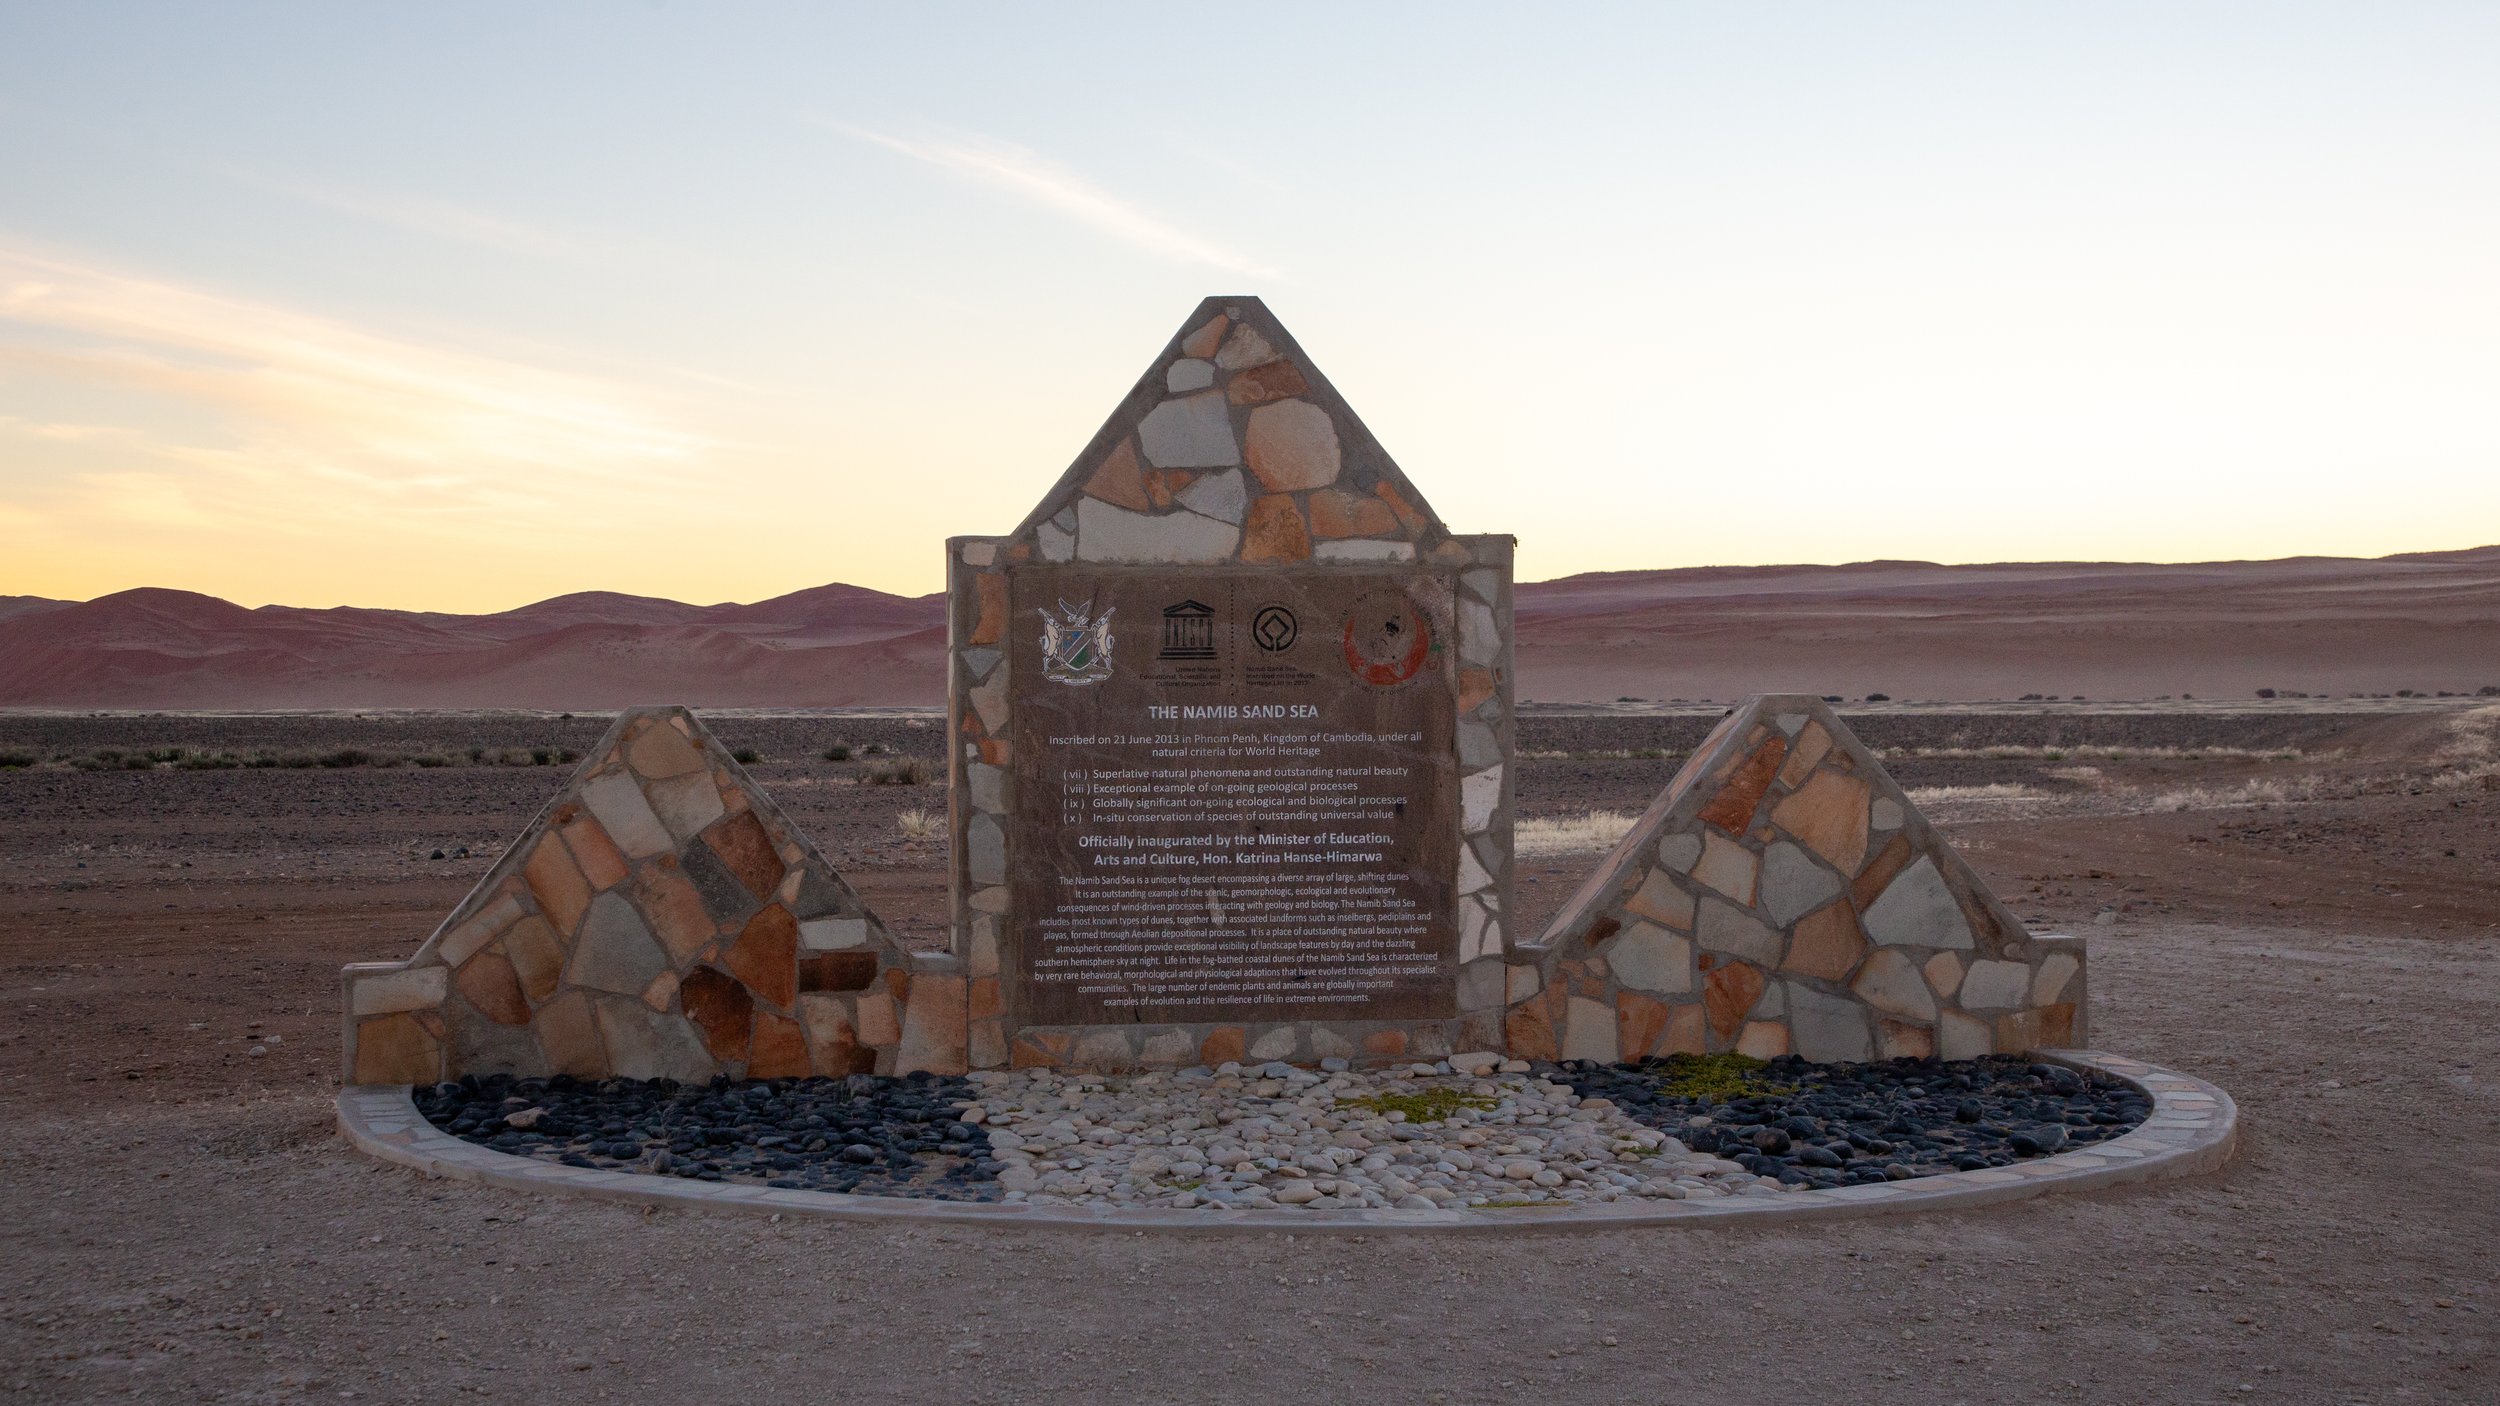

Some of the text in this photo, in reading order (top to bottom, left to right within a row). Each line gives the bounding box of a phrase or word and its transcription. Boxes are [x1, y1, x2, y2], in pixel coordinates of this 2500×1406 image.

[1148, 705, 1318, 718] THE NAMIB SAND SEA
[1113, 735, 1125, 744] 21
[1128, 735, 1151, 744] June
[1155, 734, 1179, 743] 2013
[1182, 734, 1191, 743] in
[1194, 734, 1229, 743] Phnom
[1232, 734, 1260, 744] Penh,
[1263, 733, 1306, 744] Kingdom
[1310, 733, 1320, 742] of
[1322, 732, 1375, 743] Cambodia,
[1378, 732, 1407, 741] under
[1410, 732, 1421, 741] all
[1152, 746, 1320, 757] natural criteria for World Heritage
[1093, 769, 1149, 780] Superlative
[1152, 768, 1187, 777] natural
[1190, 768, 1250, 779] phenomena
[1252, 767, 1271, 776] and
[1274, 767, 1333, 778] outstanding
[1336, 767, 1371, 776] natural
[1374, 766, 1408, 777] beauty
[1093, 783, 1150, 794] Exceptional
[1153, 783, 1195, 794] example
[1198, 782, 1208, 791] of
[1210, 782, 1254, 793] on-going
[1257, 782, 1306, 793] geological
[1310, 784, 1358, 792] processes
[1092, 798, 1133, 809] Globally
[1136, 797, 1186, 808] significant
[1189, 797, 1233, 808] on-going
[1236, 796, 1284, 808] ecological
[1287, 796, 1306, 805] and
[1309, 796, 1356, 807] biological
[1359, 798, 1407, 806] processes
[1091, 812, 1124, 821] In-situ
[1127, 812, 1191, 821] conservation
[1194, 812, 1204, 820] of
[1207, 811, 1243, 822] species
[1245, 811, 1256, 820] of
[1258, 811, 1317, 822] outstanding
[1320, 810, 1364, 819] universal
[1367, 810, 1394, 819] value
[1078, 834, 1393, 849] Officially inaugurated by the Minister of Education,
[1094, 852, 1382, 865] Arts and Culture, Hon. Katrina Hanse-Himarwa
[1150, 875, 1176, 885] unique
[1178, 875, 1190, 885] fog
[1217, 874, 1269, 884] encompassing
[1305, 875, 1324, 883] array
[1357, 873, 1384, 883] shifting
[1101, 890, 1146, 900] outstanding
[1295, 887, 1331, 897] ecological
[1349, 887, 1395, 896] evolutionary
[1057, 905, 1109, 913] consequences
[1167, 904, 1203, 912] processes
[1264, 901, 1293, 911] geology
[1056, 944, 1102, 954] atmospheric
[1144, 943, 1172, 953] provide
[1174, 942, 1216, 952] exceptional
[1218, 942, 1249, 952] visibility
[1260, 941, 1297, 951] landscape
[1341, 940, 1354, 950] day
[1386, 939, 1415, 949] dazzling
[1148, 983, 1166, 993] large
[1242, 982, 1264, 992] plants
[1326, 980, 1355, 990] globally
